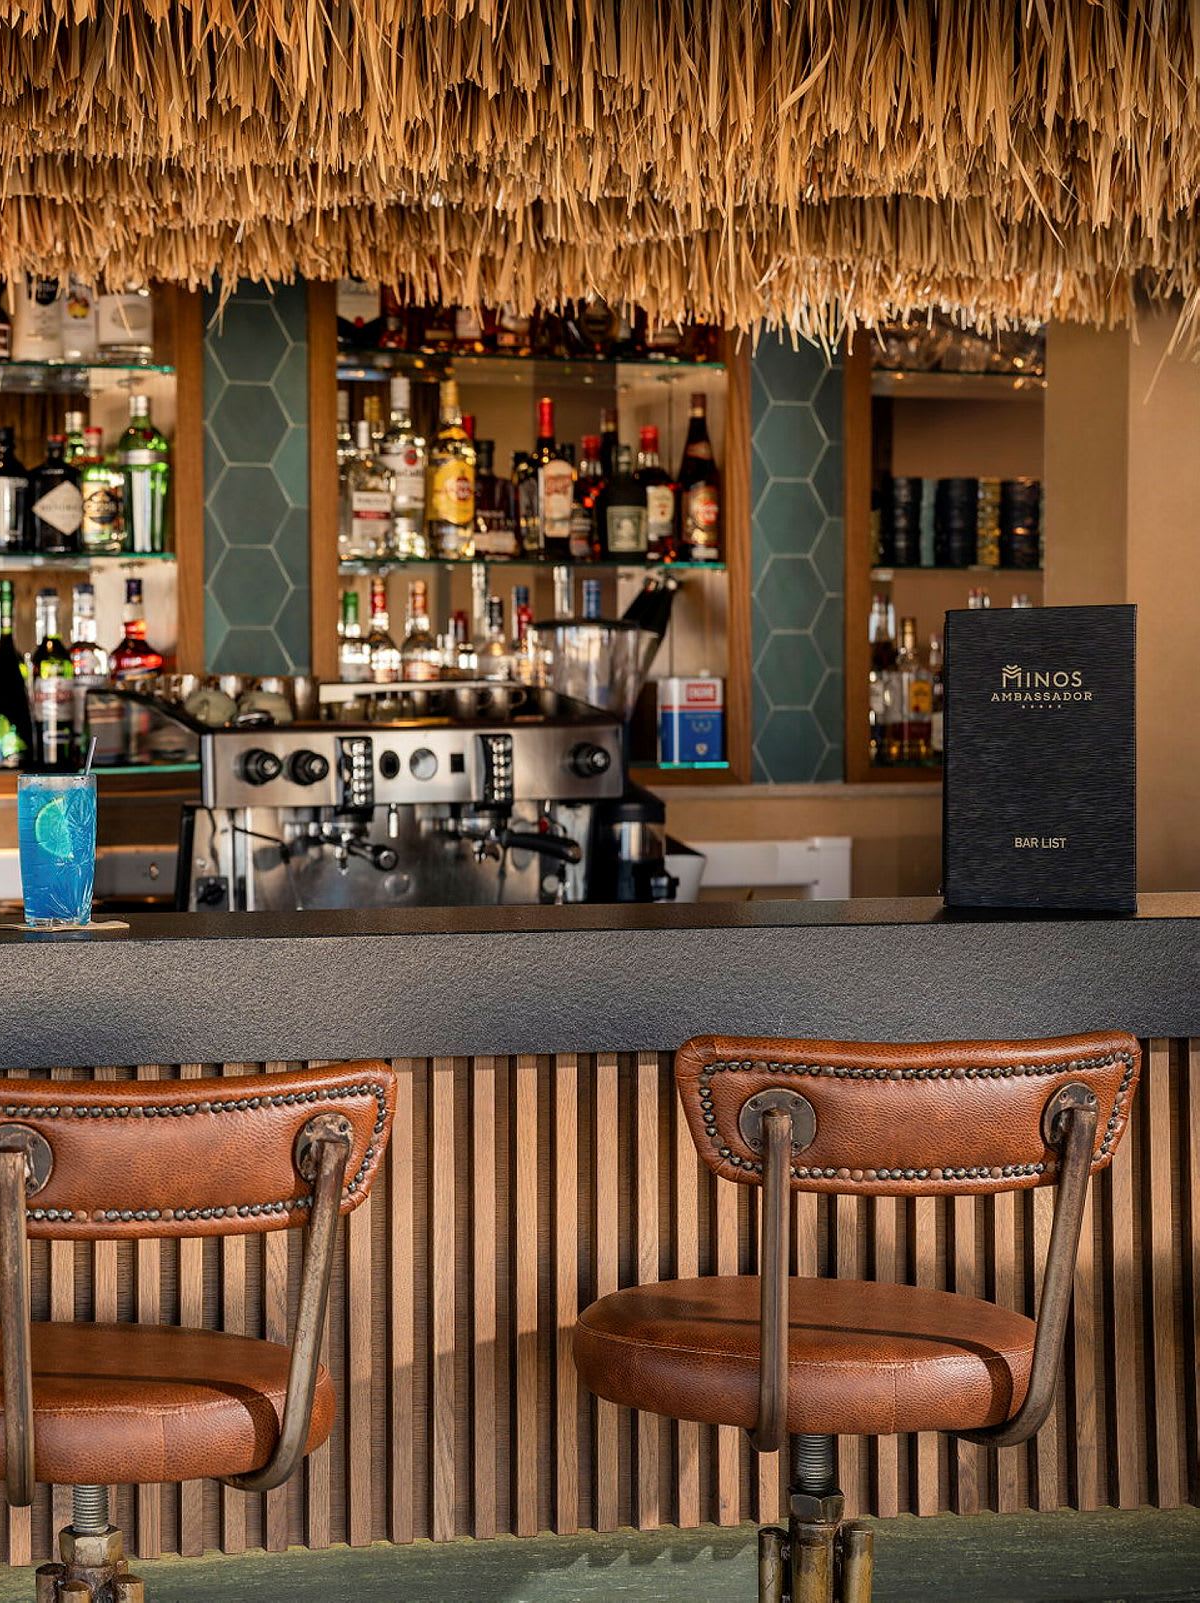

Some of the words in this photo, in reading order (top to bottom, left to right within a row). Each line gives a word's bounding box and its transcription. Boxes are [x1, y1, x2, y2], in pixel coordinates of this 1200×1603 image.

[1002, 664, 1082, 688] MINOS
[991, 691, 1093, 702] AMBASSADOR
[1014, 837, 1039, 849] BAR
[1041, 837, 1067, 849] LIST
